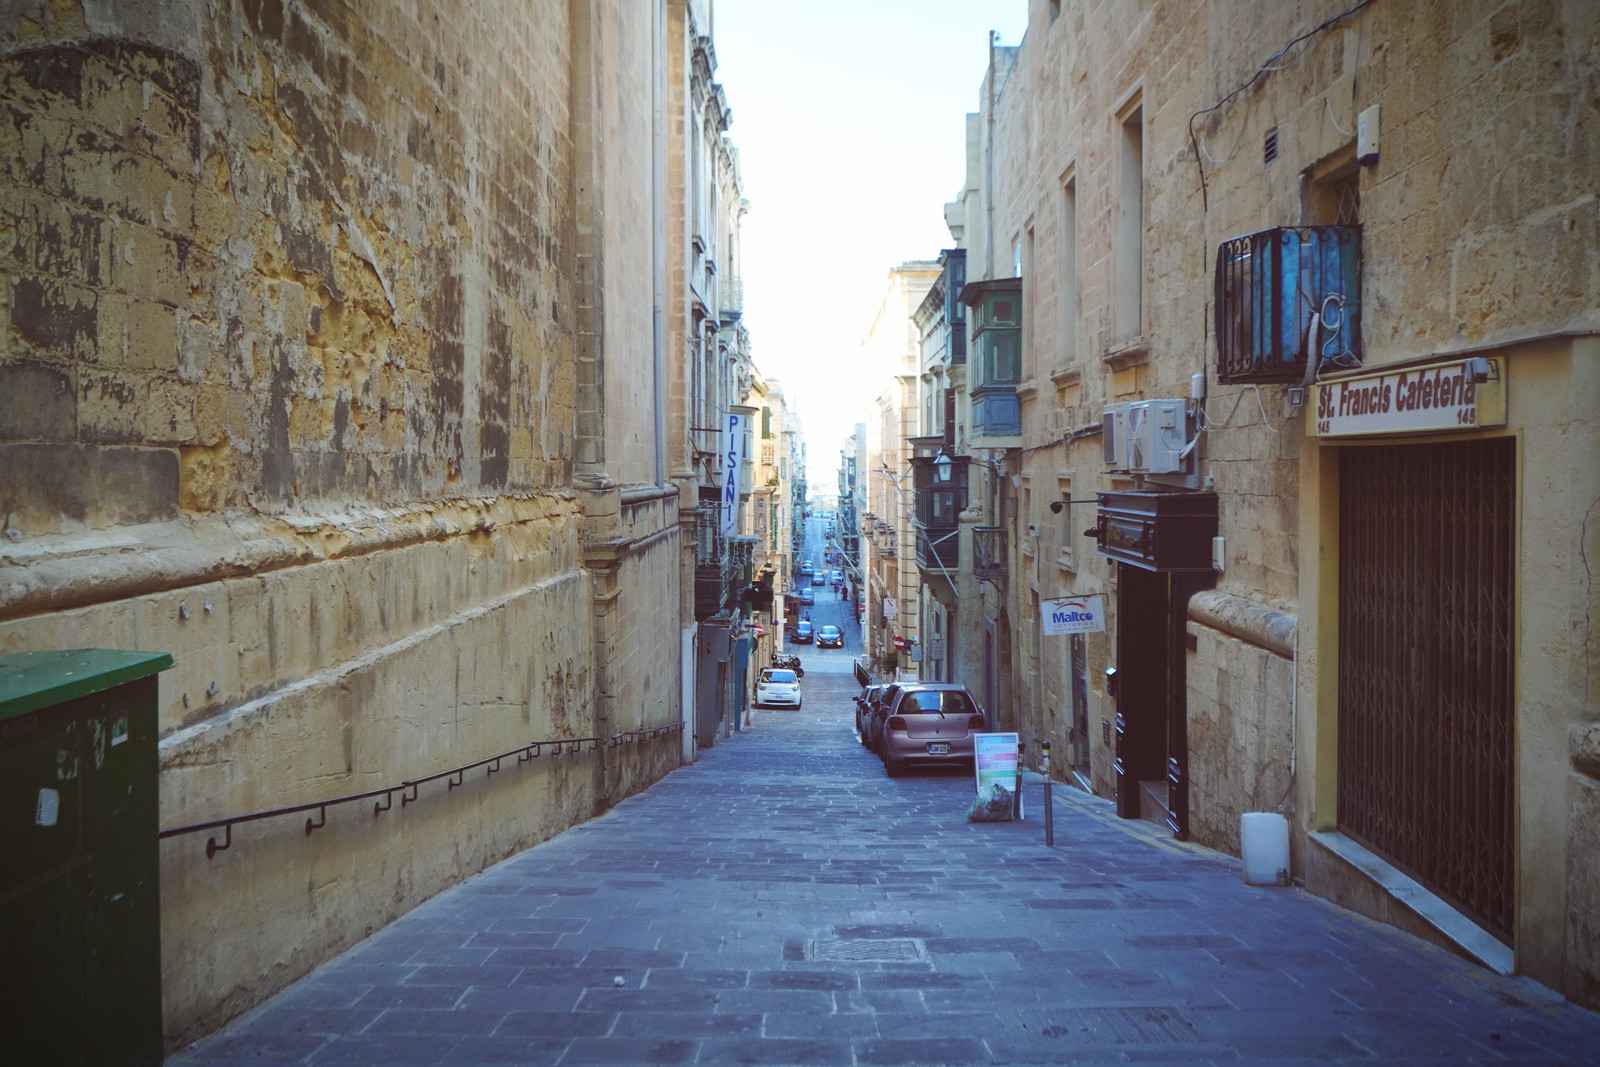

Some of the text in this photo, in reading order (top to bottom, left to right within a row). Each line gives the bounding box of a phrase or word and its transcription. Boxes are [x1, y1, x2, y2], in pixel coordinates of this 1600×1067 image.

[1318, 364, 1475, 419] St. Francis Cafeteria
[726, 415, 738, 521] PISANI
